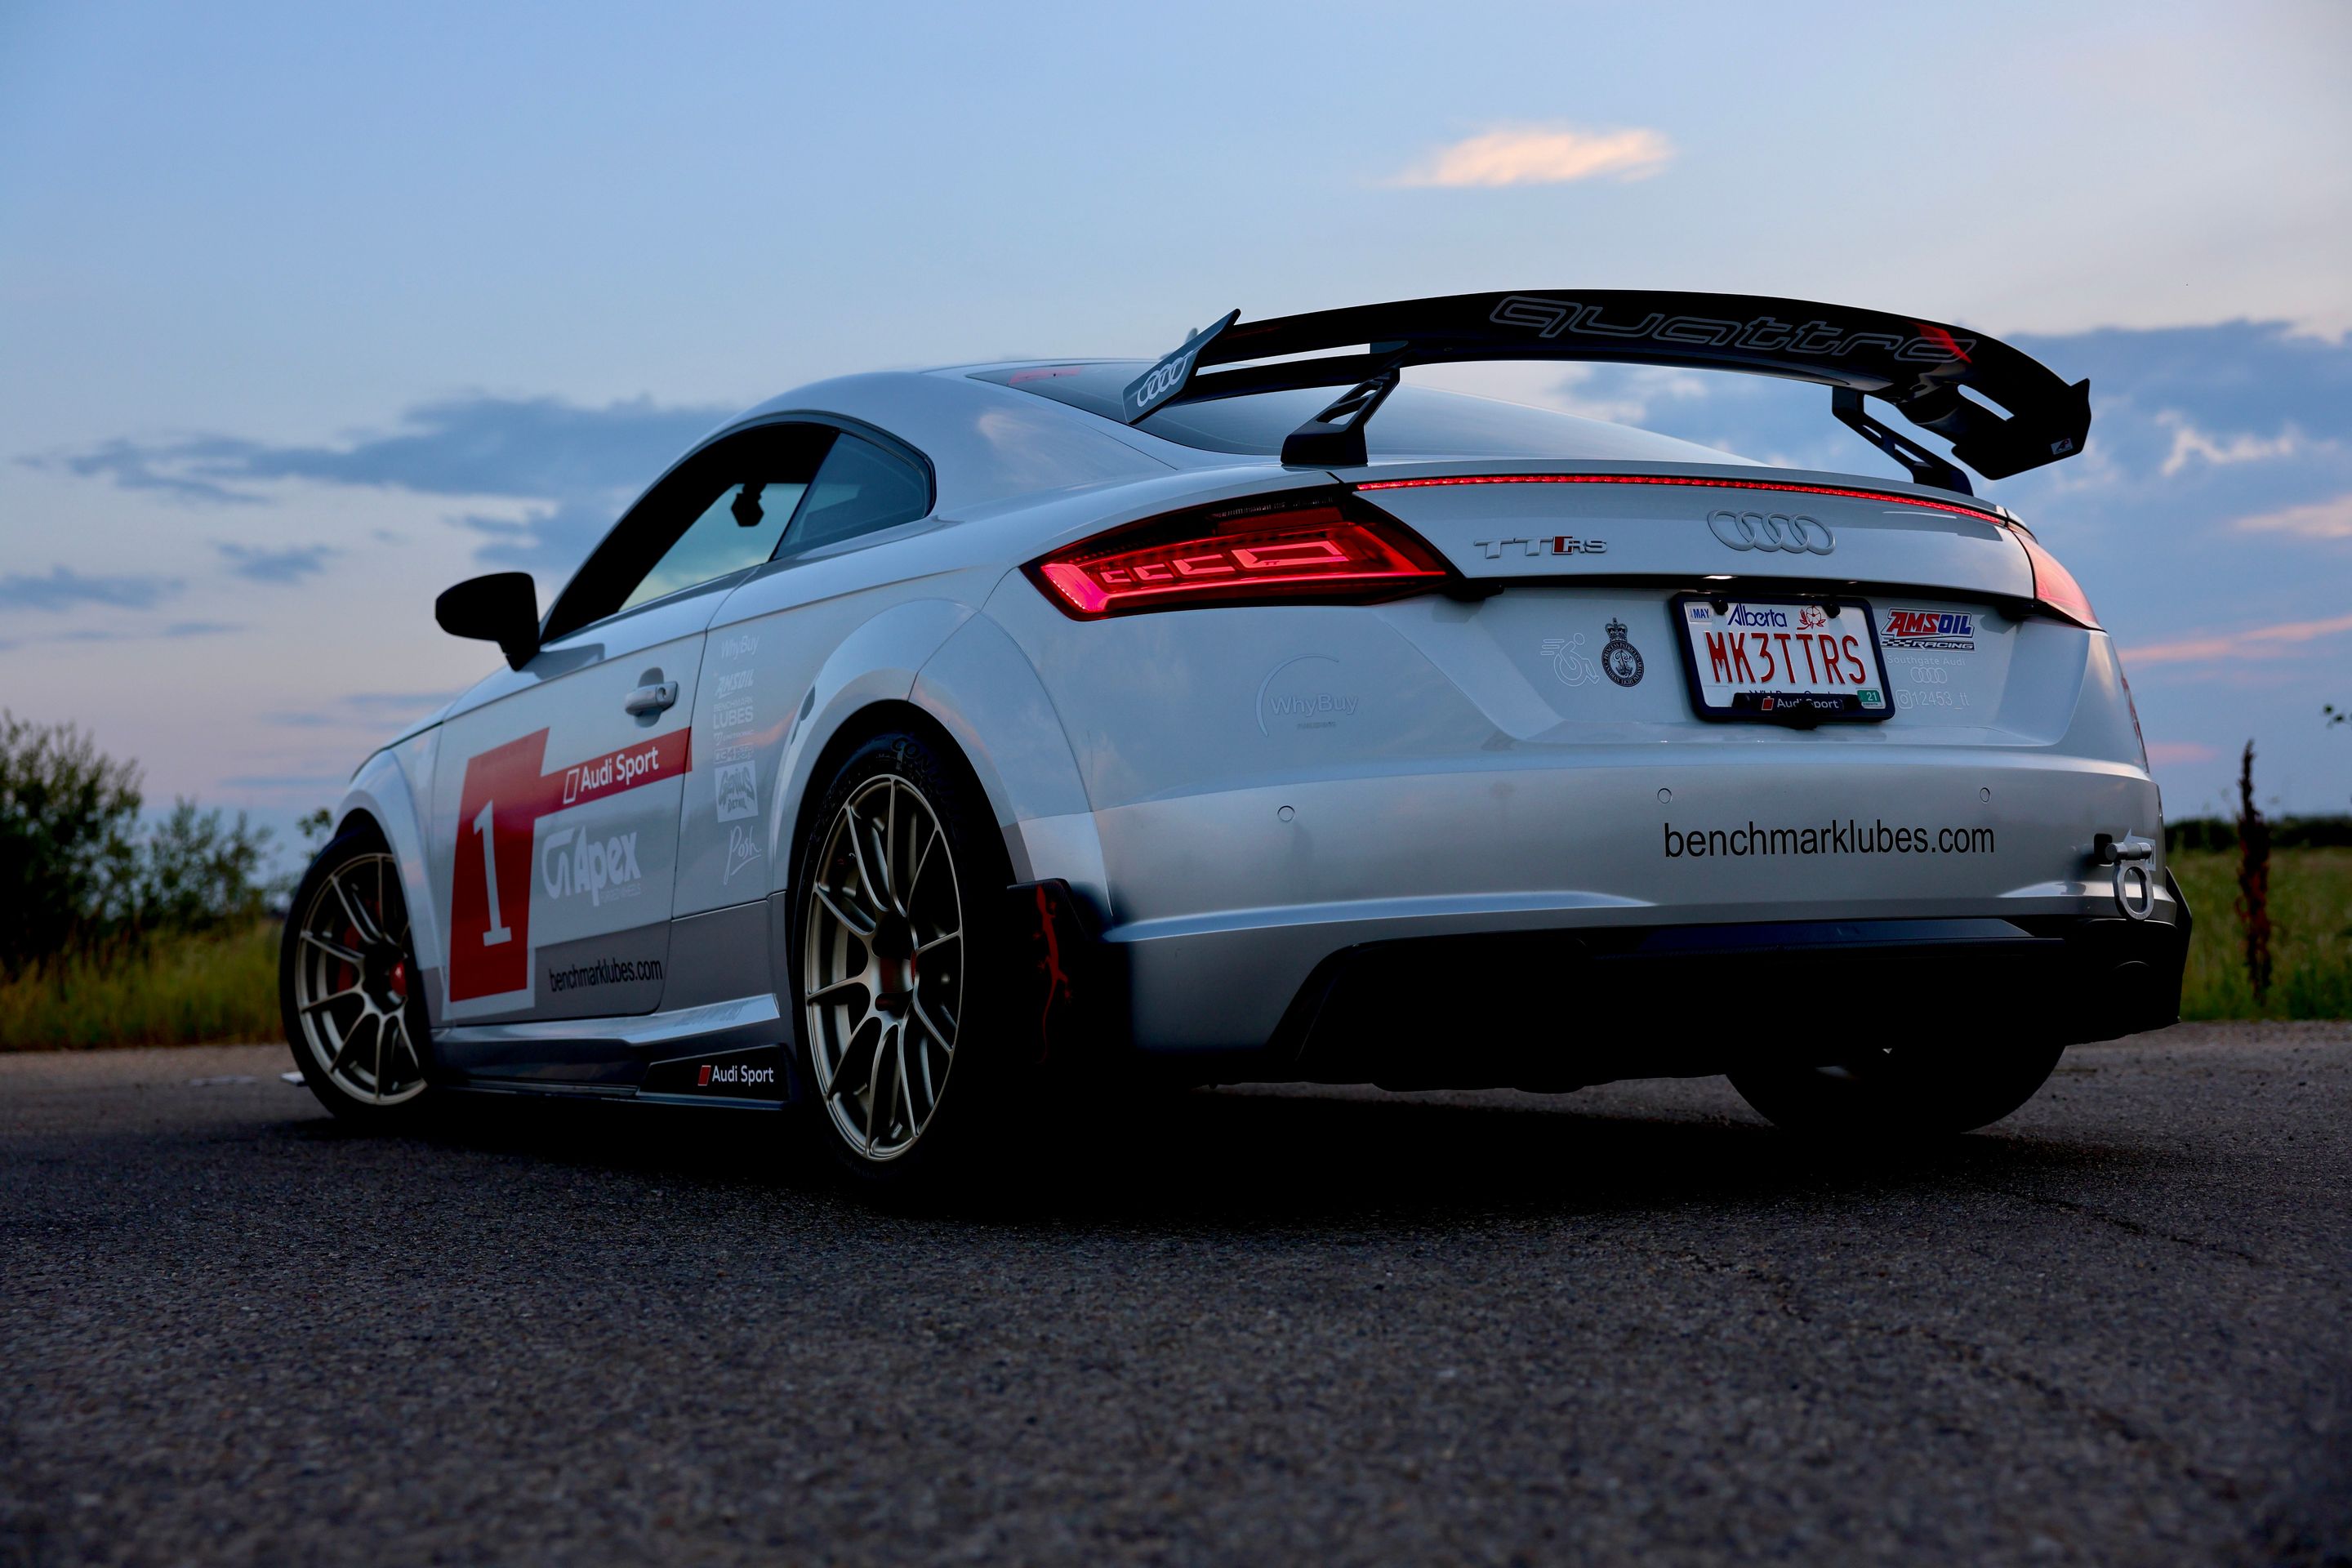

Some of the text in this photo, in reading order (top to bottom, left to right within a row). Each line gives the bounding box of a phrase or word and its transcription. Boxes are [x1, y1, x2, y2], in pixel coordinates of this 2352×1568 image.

[1489, 295, 1976, 363] quattro
[1692, 604, 1788, 628] MAY Alberta
[1886, 612, 1972, 637] AMSOIL
[1704, 631, 1867, 684] MK3TTRS
[1912, 640, 1973, 650] RACING
[1886, 655, 1967, 666] Southgate Audi
[714, 668, 755, 699] AMSOIL
[1269, 693, 1358, 718] WhyBuy
[1777, 698, 1839, 709] Aud port
[1866, 692, 1878, 702] 21
[712, 706, 754, 729] LUBES
[580, 746, 660, 792] Audi Sport
[1663, 818, 1995, 858] benchmarklubes.com
[723, 825, 762, 886] Posh
[473, 799, 512, 947] 1
[548, 956, 664, 993] benchmarklubes.com
[711, 1065, 774, 1087] Audi Sport
